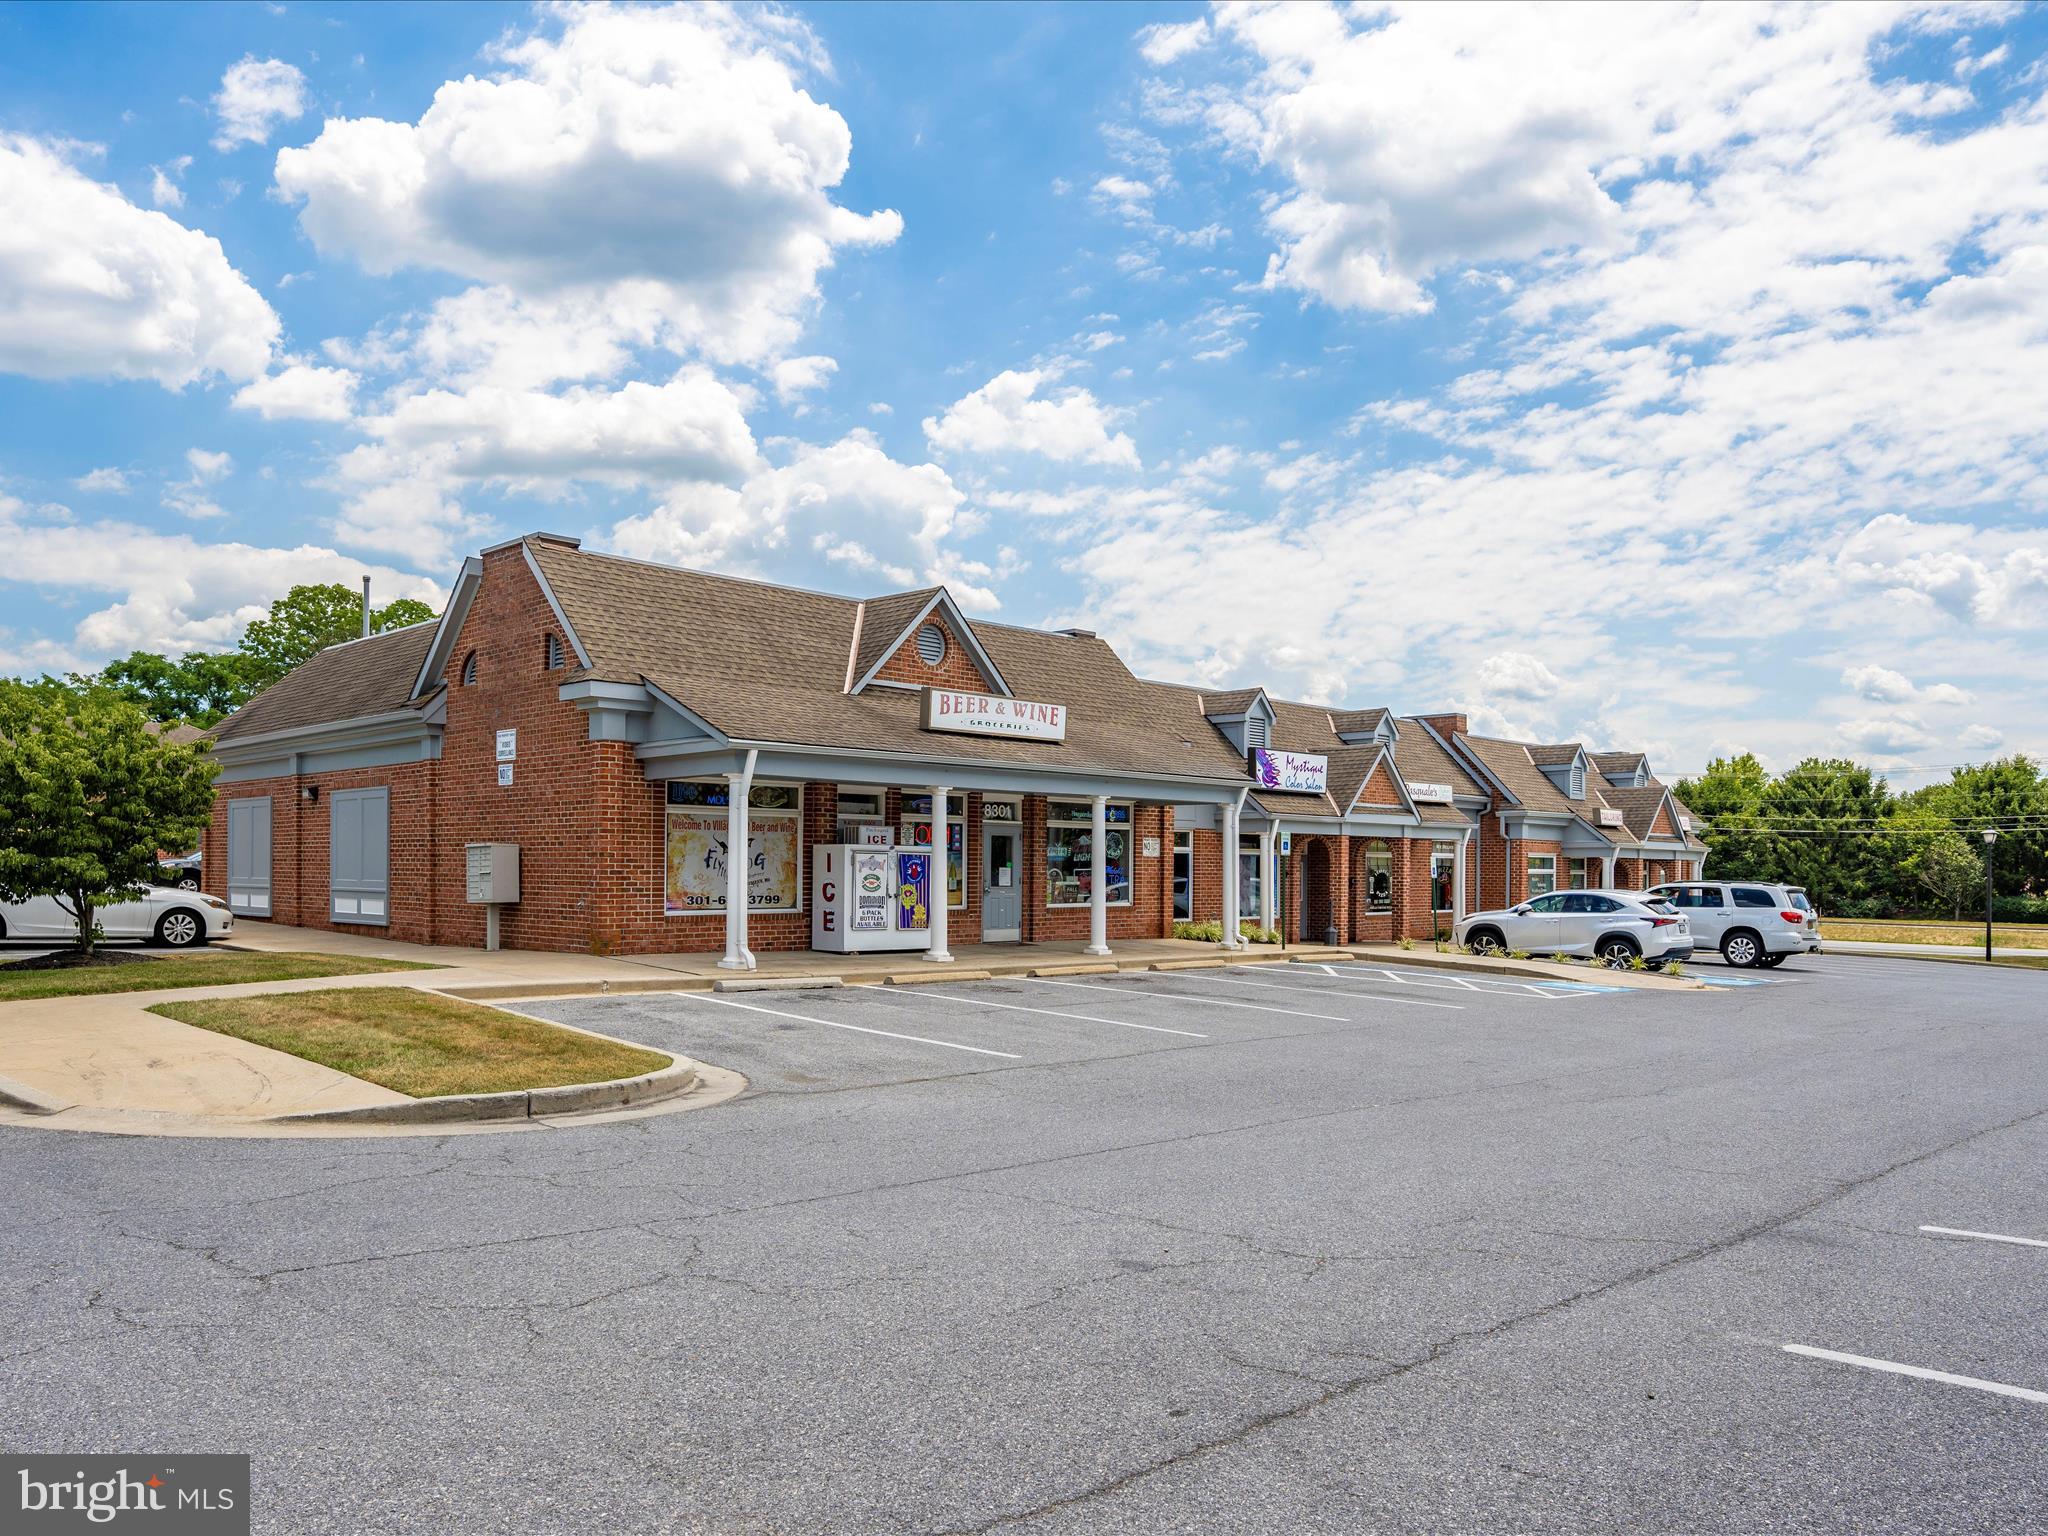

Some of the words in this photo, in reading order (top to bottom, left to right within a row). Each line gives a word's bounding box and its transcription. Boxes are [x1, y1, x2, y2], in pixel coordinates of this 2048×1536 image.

[939, 694, 988, 715] BEER
[995, 702, 1006, 715] &
[1013, 702, 1059, 727] WINE
[970, 719, 1031, 731] GROCERIES
[1286, 754, 1324, 777] Mystique
[1286, 776, 1303, 788] Color
[1305, 777, 1323, 790] Salon
[984, 804, 1010, 818] 8301
[671, 819, 701, 830] Welcome
[703, 820, 711, 830] To
[712, 820, 729, 832] Villa
[751, 821, 765, 832] Beer
[767, 823, 779, 832] and
[867, 835, 888, 844] ICE
[1073, 853, 1093, 862] LIGH
[822, 852, 836, 932] ICE
[686, 894, 780, 906] 301-63799
